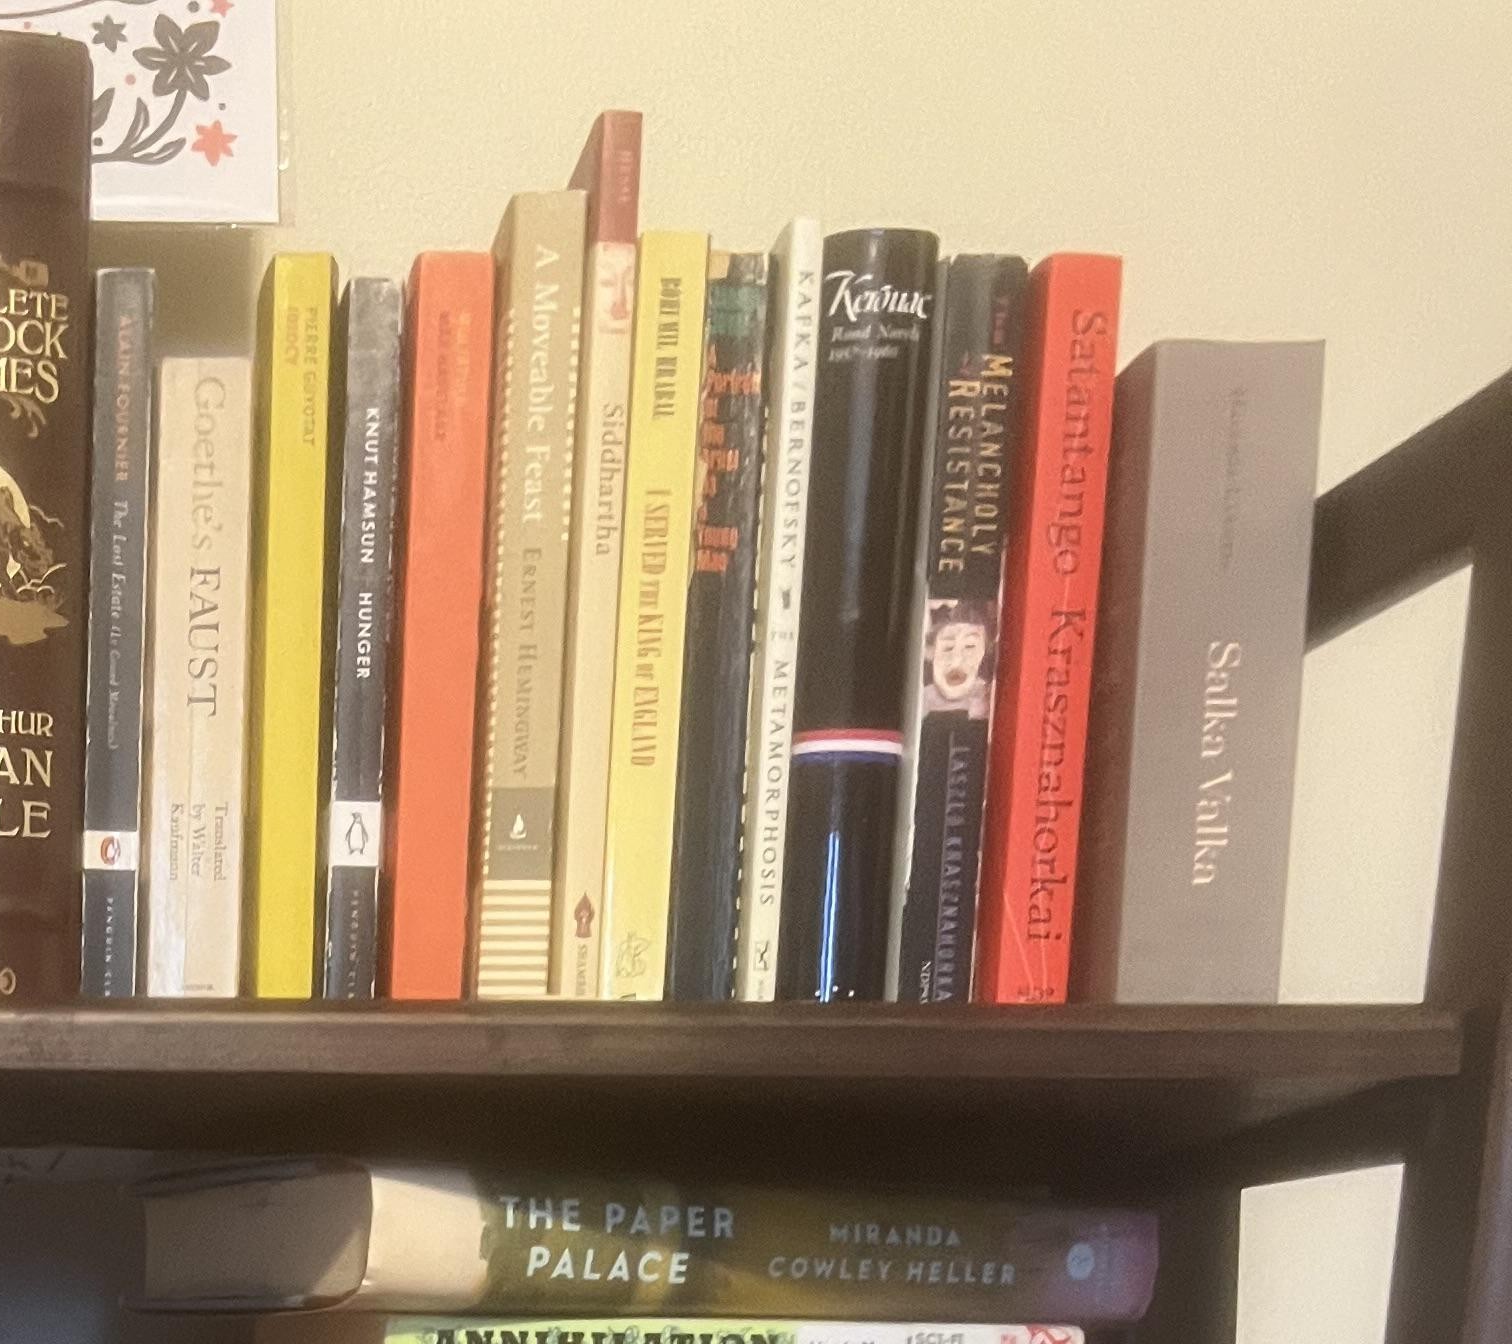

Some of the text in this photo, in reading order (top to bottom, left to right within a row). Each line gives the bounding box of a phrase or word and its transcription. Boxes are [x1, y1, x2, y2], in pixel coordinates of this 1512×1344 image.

[186, 376, 226, 717] Goethe's FAUST
[356, 408, 381, 680] KNUT HAMSUN HUNGER
[596, 401, 625, 557] Siddhartha
[759, 658, 789, 906] METAMORPHOSIS
[1192, 641, 1242, 886] Salka Valka
[499, 1195, 735, 1240] THE PAPER
[526, 1246, 691, 1286] PALACE
[767, 1255, 1016, 1288] COWLEY HELLER
